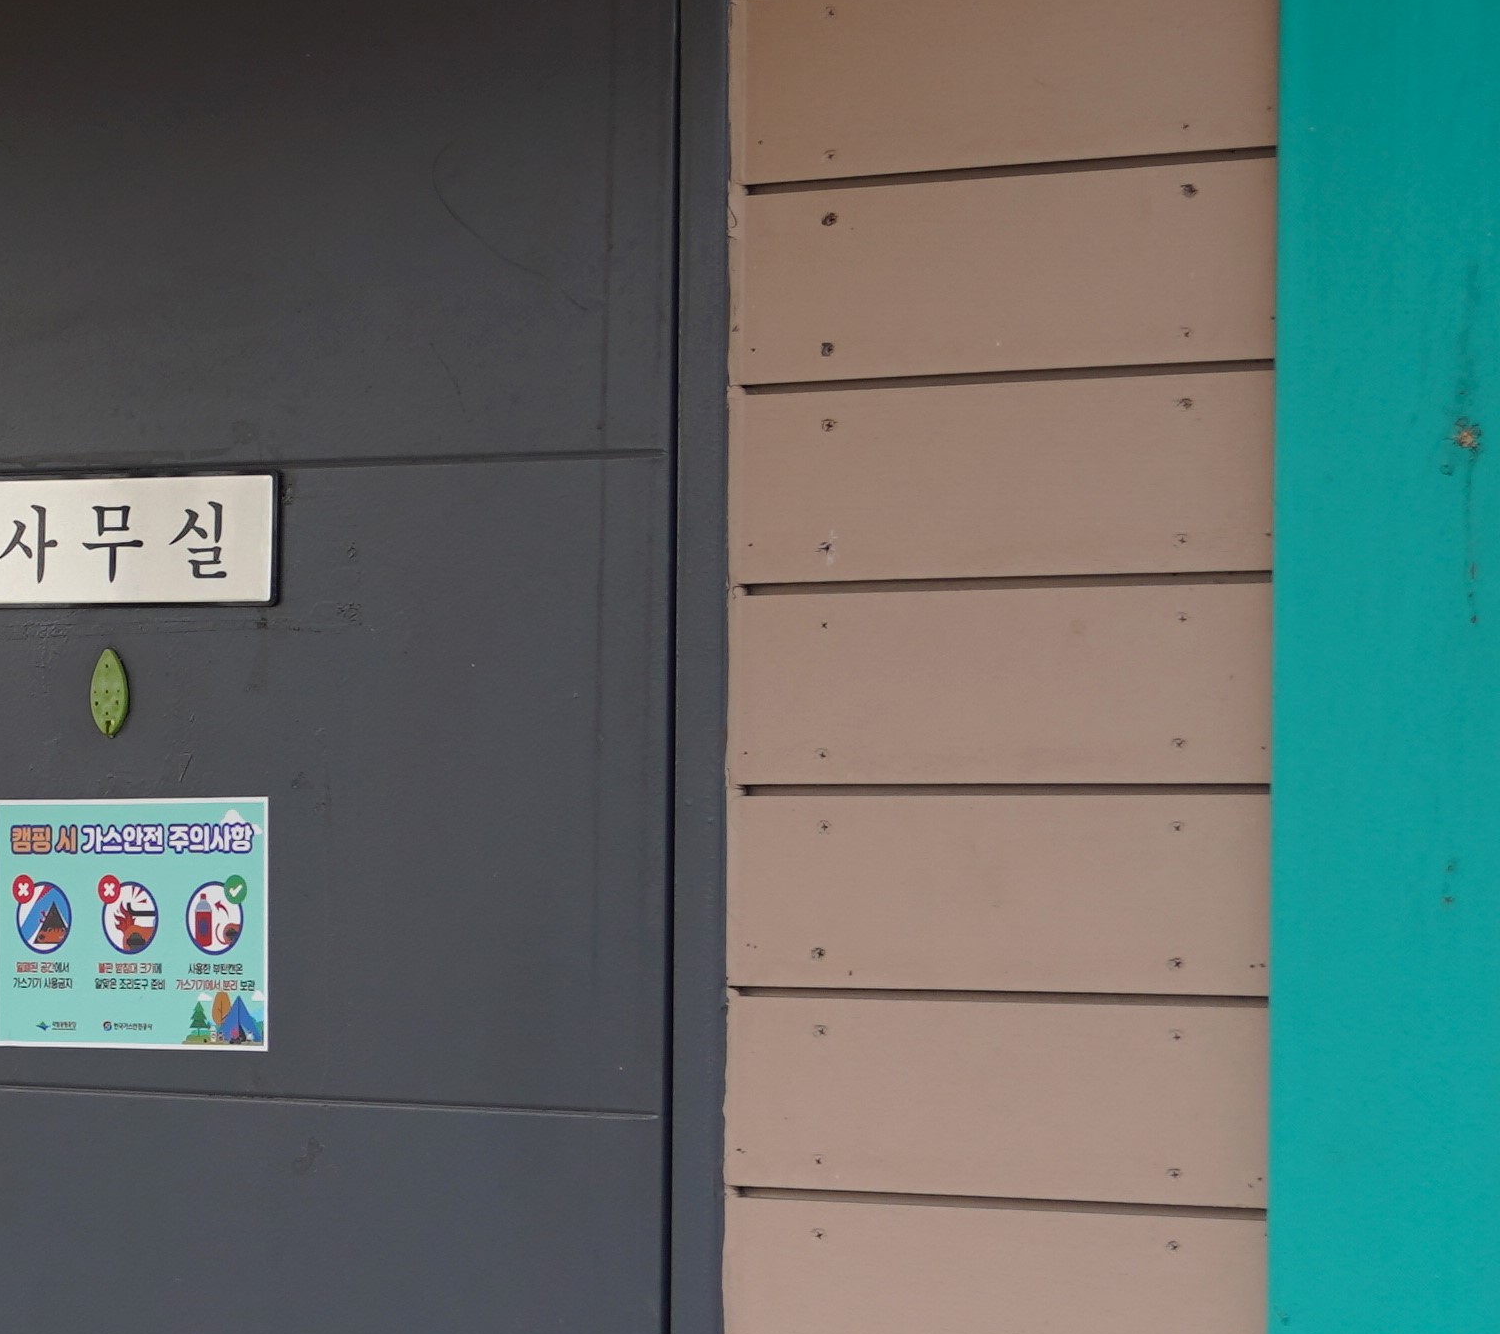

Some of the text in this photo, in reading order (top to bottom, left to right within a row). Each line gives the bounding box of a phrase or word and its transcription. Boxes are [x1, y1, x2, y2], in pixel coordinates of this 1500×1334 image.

[12, 823, 253, 854] 캠핑 시 가스안전 주의사항
